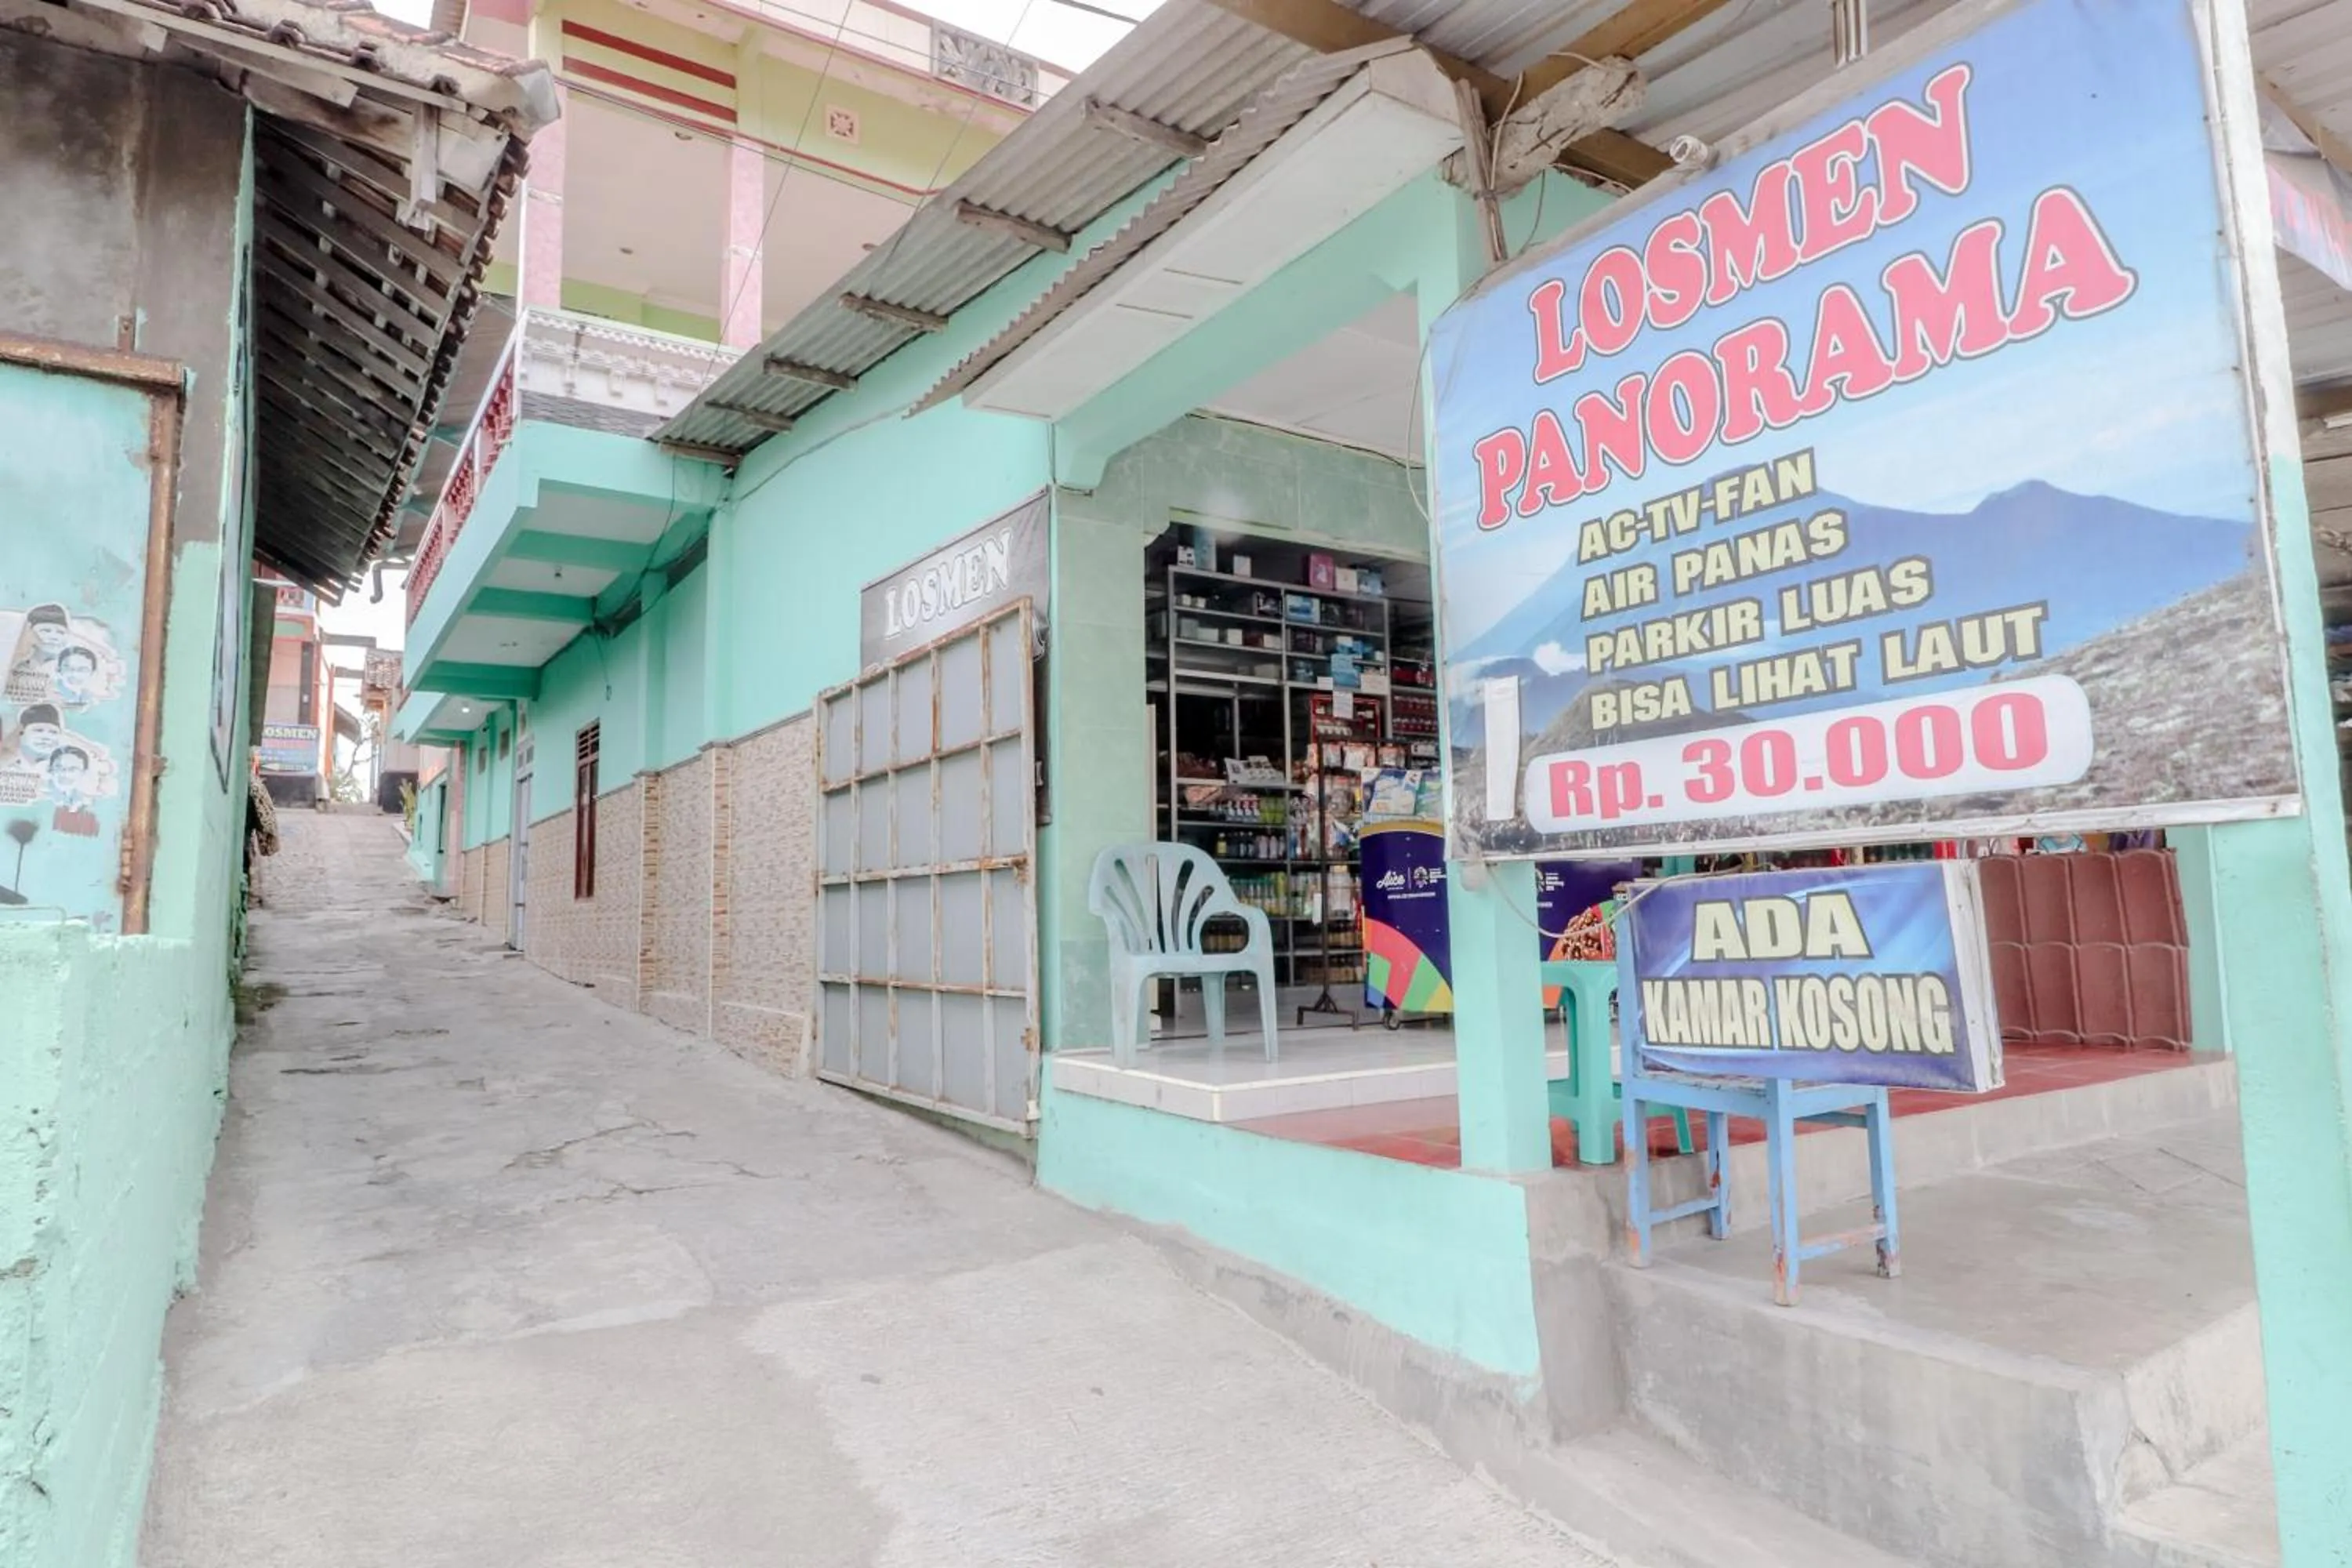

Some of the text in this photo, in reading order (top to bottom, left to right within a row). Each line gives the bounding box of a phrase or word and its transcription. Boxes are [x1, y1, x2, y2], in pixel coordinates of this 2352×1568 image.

[1529, 63, 1972, 384] LOSMEN
[1475, 184, 2139, 530] PANORAMA
[1576, 448, 1817, 565] AC-TV-FAN
[884, 528, 1013, 640] LOSMEN
[1581, 510, 1849, 622] AIR PANAS
[1584, 556, 1933, 676] PARKIR LUAS
[1589, 601, 2048, 733] BISA LIHAT LAUT
[263, 726, 318, 739] OSMEN
[1548, 691, 2048, 819] Rp. 30.000
[1691, 889, 1874, 963] ADA
[1641, 971, 1956, 1055] KAMAR KOSONG
